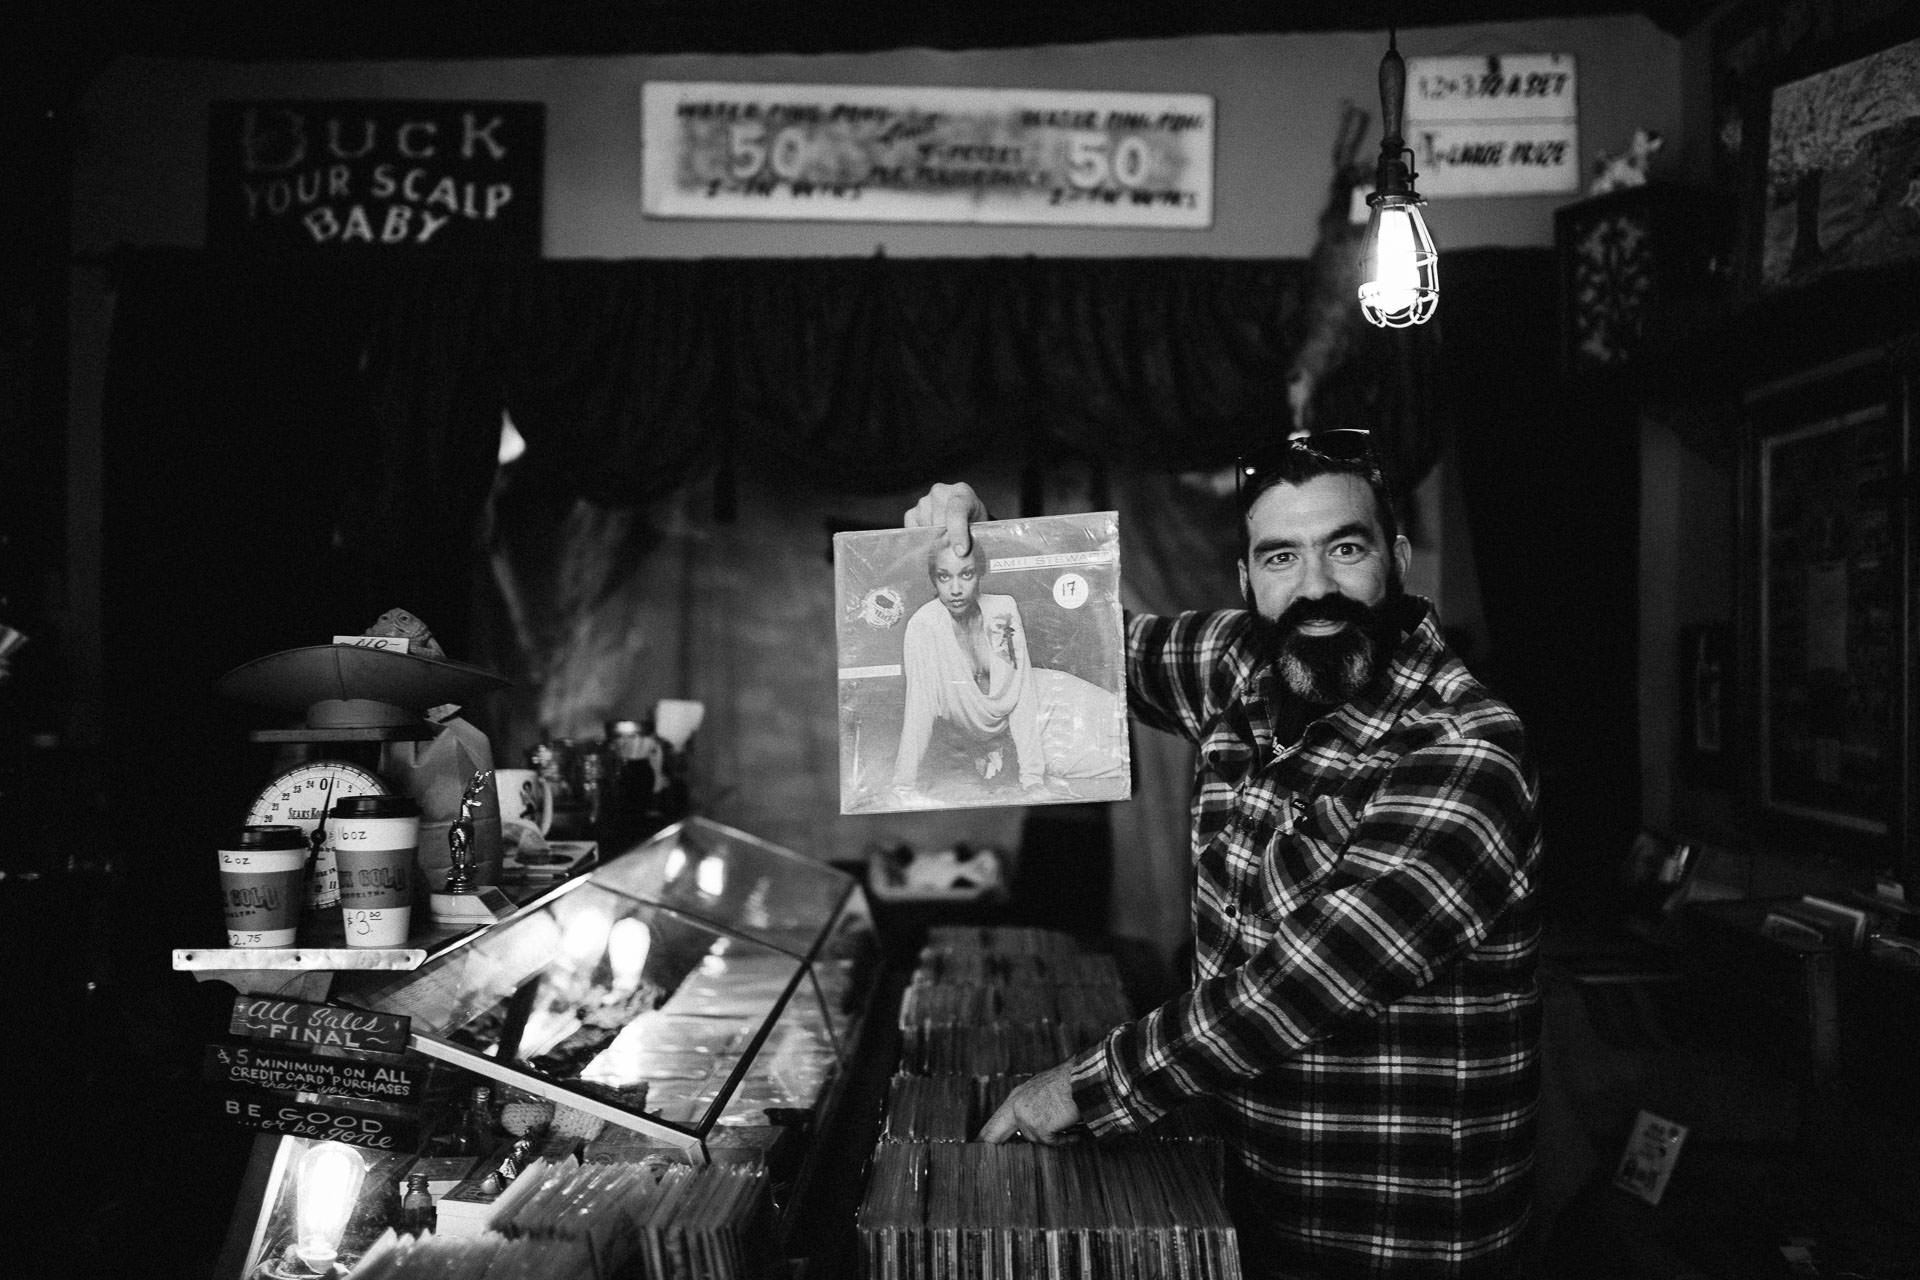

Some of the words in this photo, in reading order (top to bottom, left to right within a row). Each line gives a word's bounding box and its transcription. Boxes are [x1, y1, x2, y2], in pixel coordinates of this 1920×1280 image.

[243, 164, 351, 218] YOUR
[371, 163, 514, 220] SCALP
[302, 203, 450, 243] BABY
[1062, 580, 1076, 597] 17
[309, 1008, 386, 1032] Sales
[269, 1024, 360, 1048] FINAL
[231, 1066, 283, 1081] CREDIT
[286, 1072, 325, 1086] CARD
[332, 1076, 410, 1096] PURCHASES
[255, 1058, 334, 1075] MINIMUM
[344, 1068, 366, 1078] ON
[374, 1068, 411, 1084] ALL
[225, 1101, 262, 1118] BE
[278, 1108, 383, 1133] GOOD
[293, 1121, 319, 1135] be
[319, 1126, 393, 1149] gone
